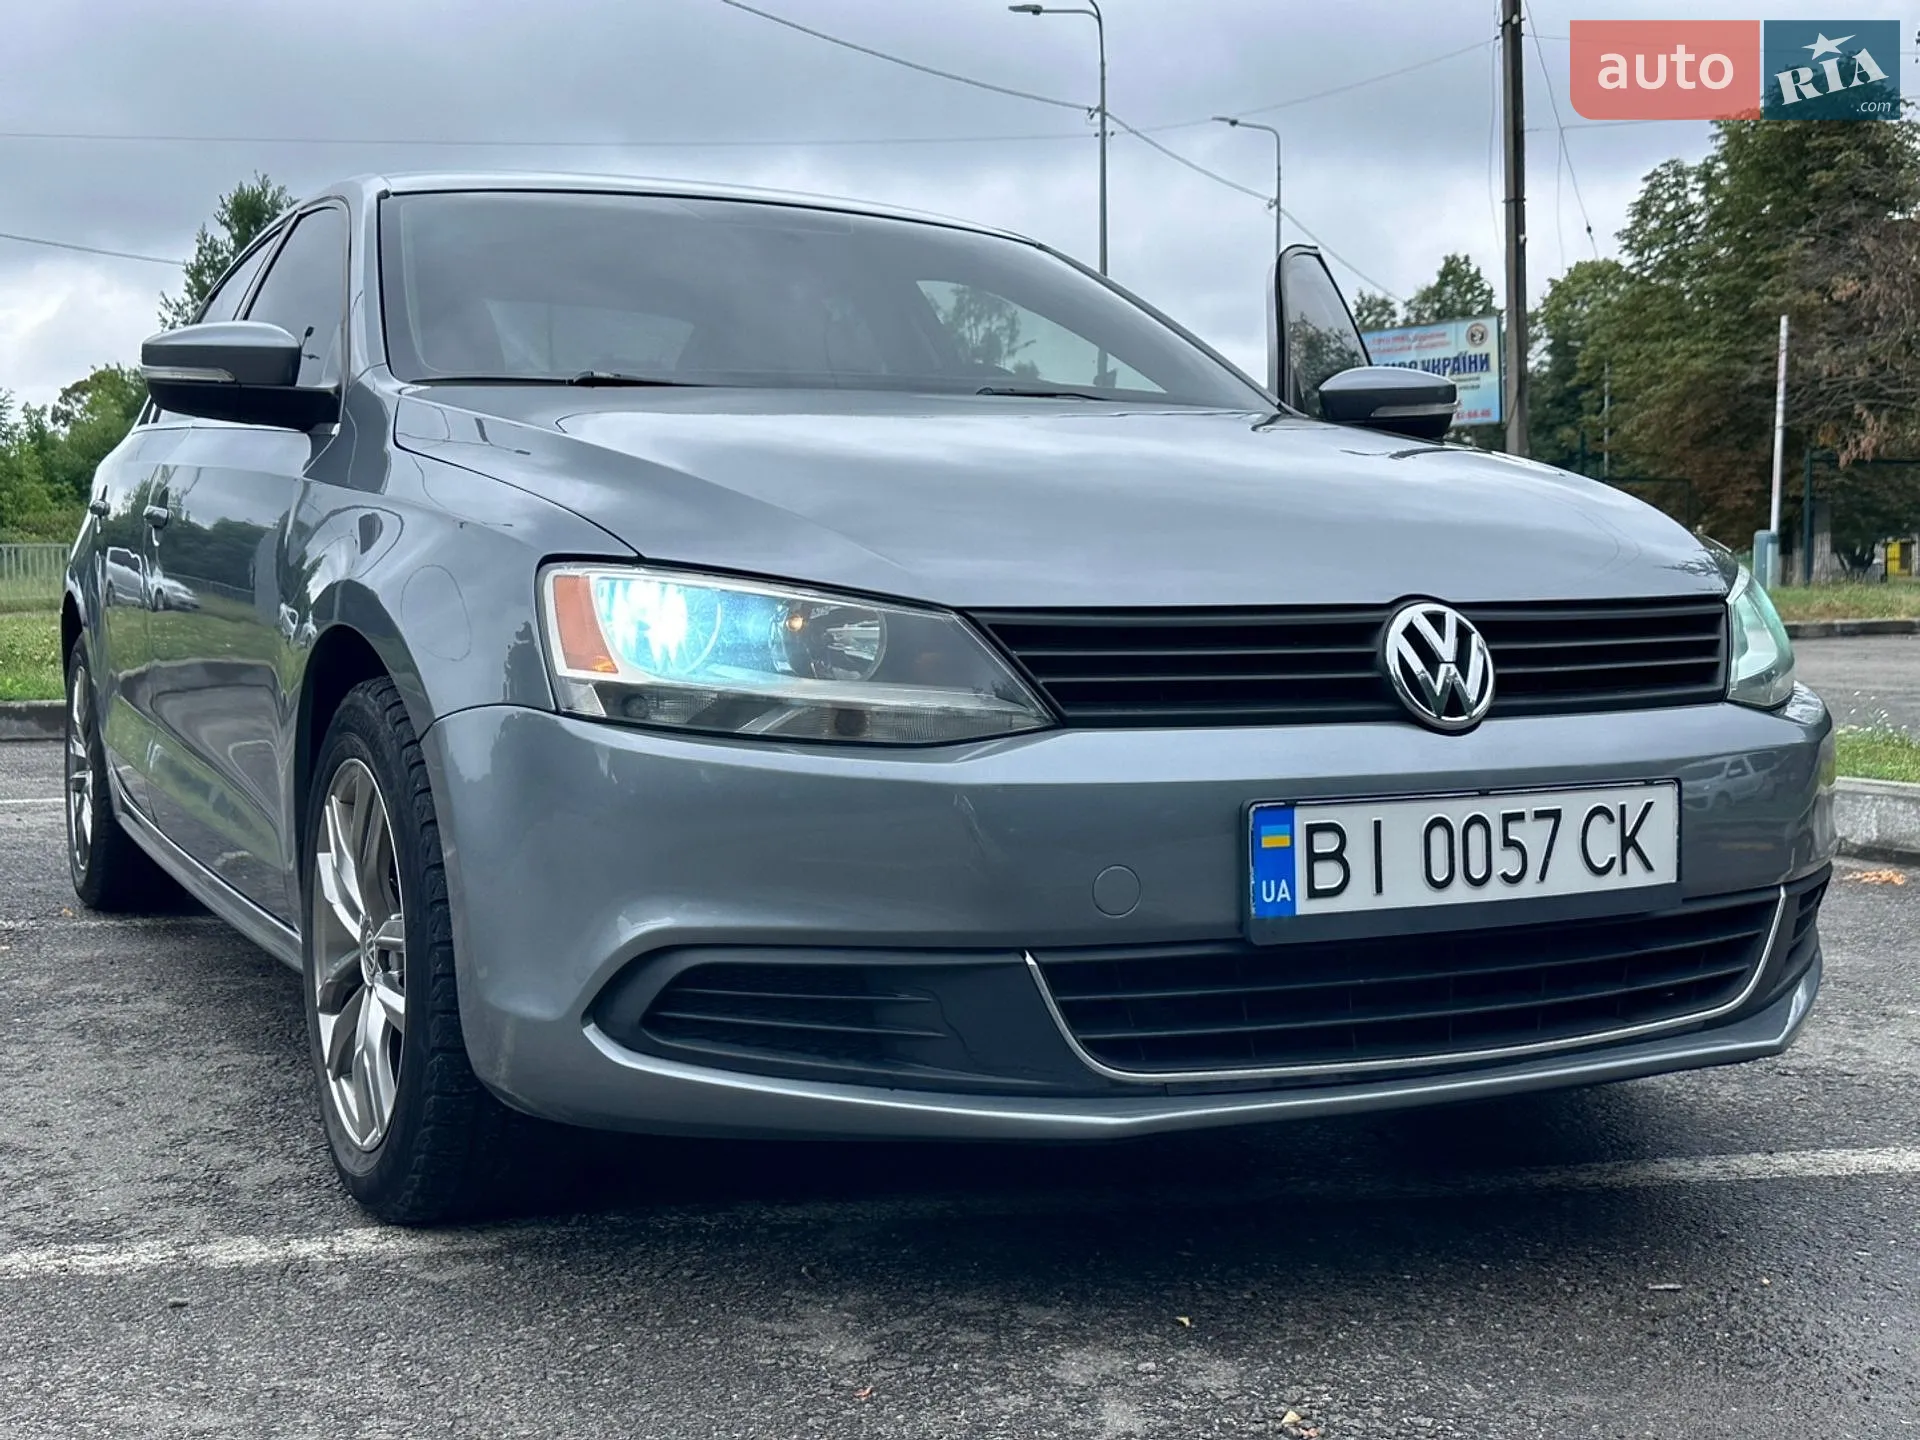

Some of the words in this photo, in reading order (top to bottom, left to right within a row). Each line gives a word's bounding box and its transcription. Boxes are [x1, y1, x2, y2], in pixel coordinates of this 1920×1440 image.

[1304, 818, 1384, 899] BI
[1423, 807, 1563, 890] 0057
[1580, 800, 1655, 876] CK
[1261, 879, 1292, 903] UA
